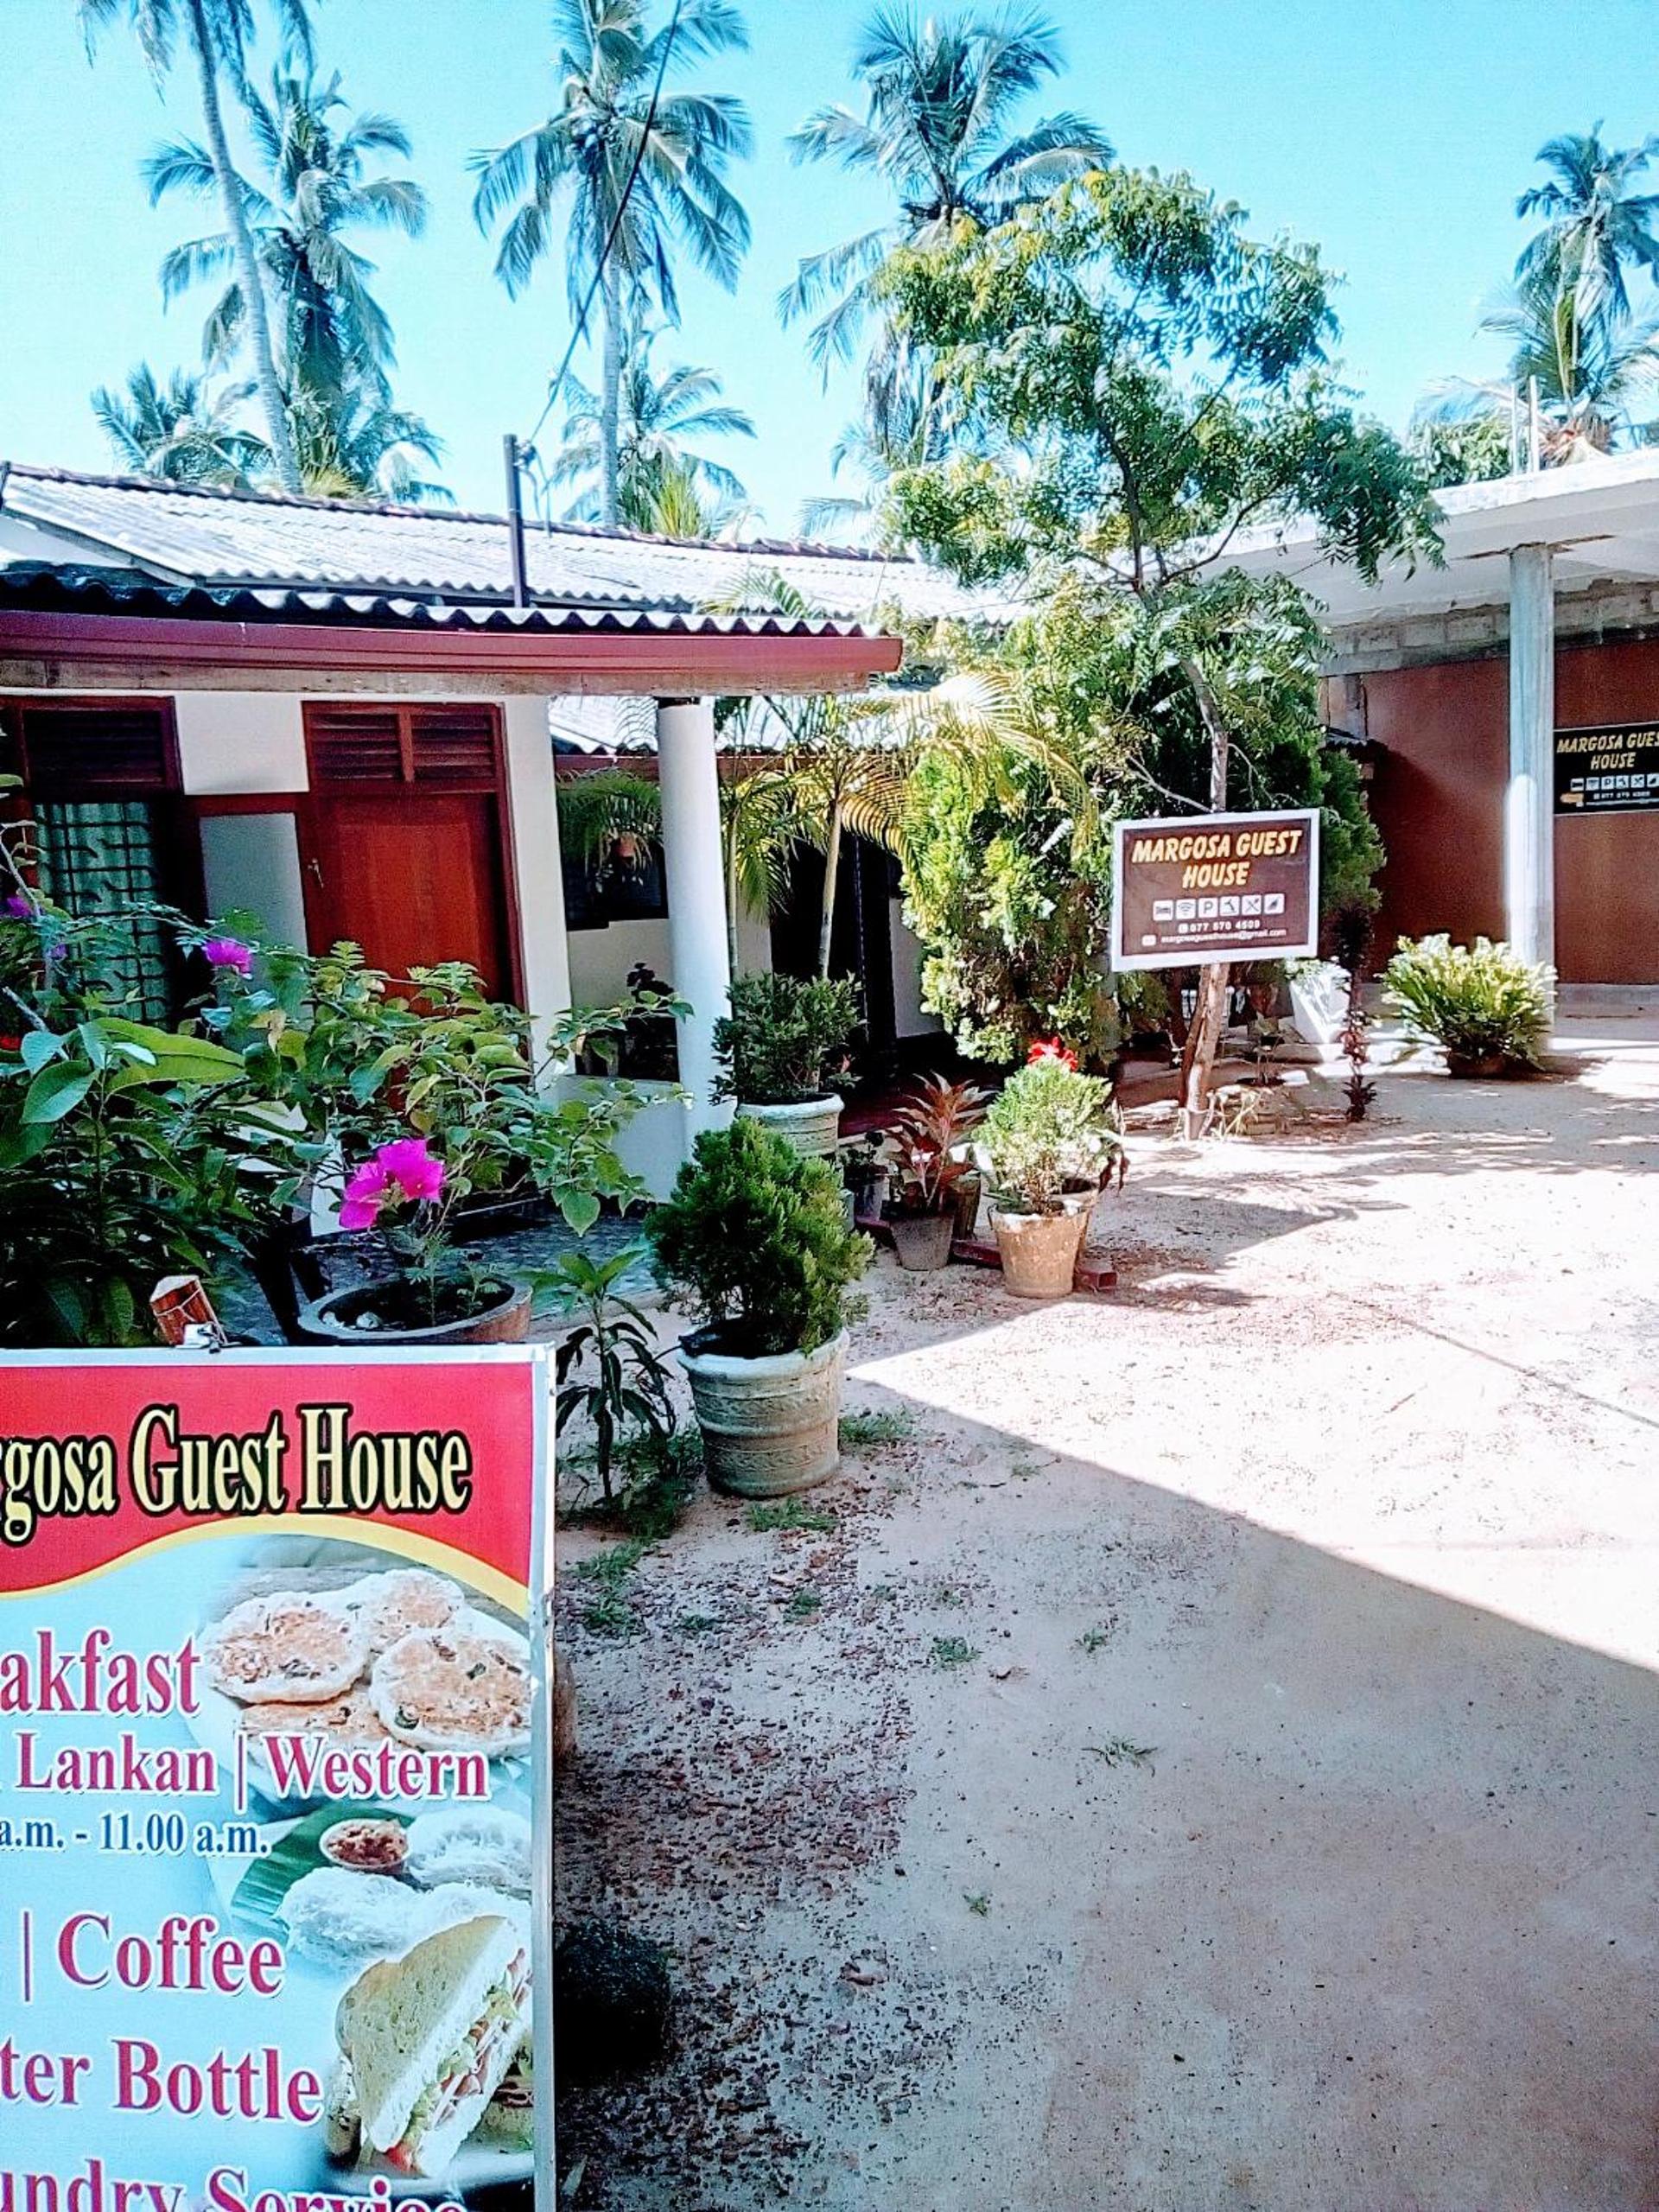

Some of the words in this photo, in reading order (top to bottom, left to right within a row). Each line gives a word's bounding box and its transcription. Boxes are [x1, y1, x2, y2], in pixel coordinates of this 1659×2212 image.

[1557, 734, 1623, 753] MARGOSA
[1591, 752, 1637, 770] HOUSE
[1132, 834, 1230, 863] MARGOSA
[1236, 829, 1303, 857] GUEST
[1182, 861, 1250, 889] HOUSE
[0, 1437, 118, 1544] gosa
[131, 1404, 288, 1515] Guest
[297, 1403, 472, 1514] House
[0, 1629, 200, 1714] akfast
[14, 1732, 217, 1794] Lankan
[264, 1734, 488, 1797] Western
[0, 1819, 64, 1849] a.m.
[100, 1813, 185, 1852] 11.00
[196, 1824, 269, 1854] a.m.
[57, 1914, 283, 1994] Coffee
[0, 2037, 90, 2105] ter
[112, 2039, 322, 2122] Bottle
